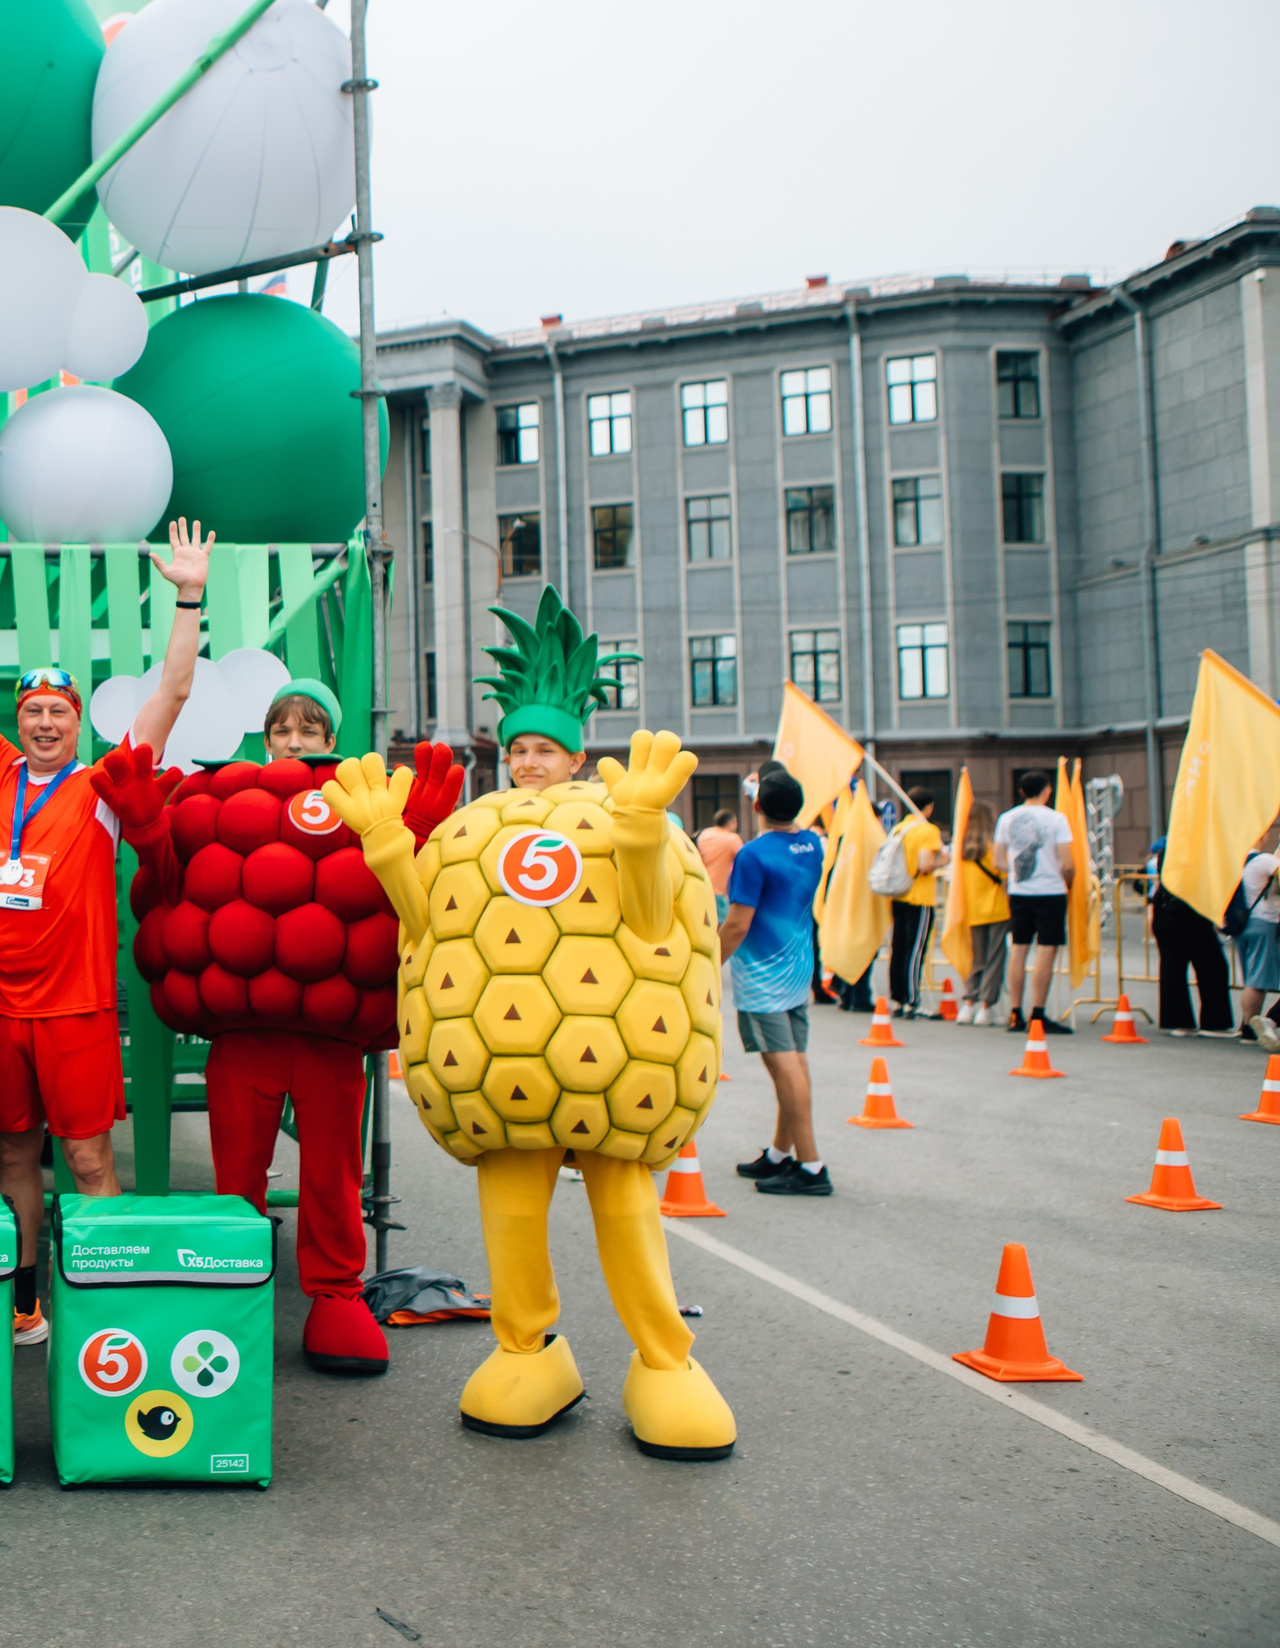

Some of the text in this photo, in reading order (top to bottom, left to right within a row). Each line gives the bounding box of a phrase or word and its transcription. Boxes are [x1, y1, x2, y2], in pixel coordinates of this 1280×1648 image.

[301, 789, 330, 825] 5
[517, 834, 568, 891] 5
[71, 1244, 150, 1257] Доставляем
[72, 1257, 134, 1270] продукты
[95, 1334, 131, 1384] 5
[215, 1459, 245, 1468] 25142
